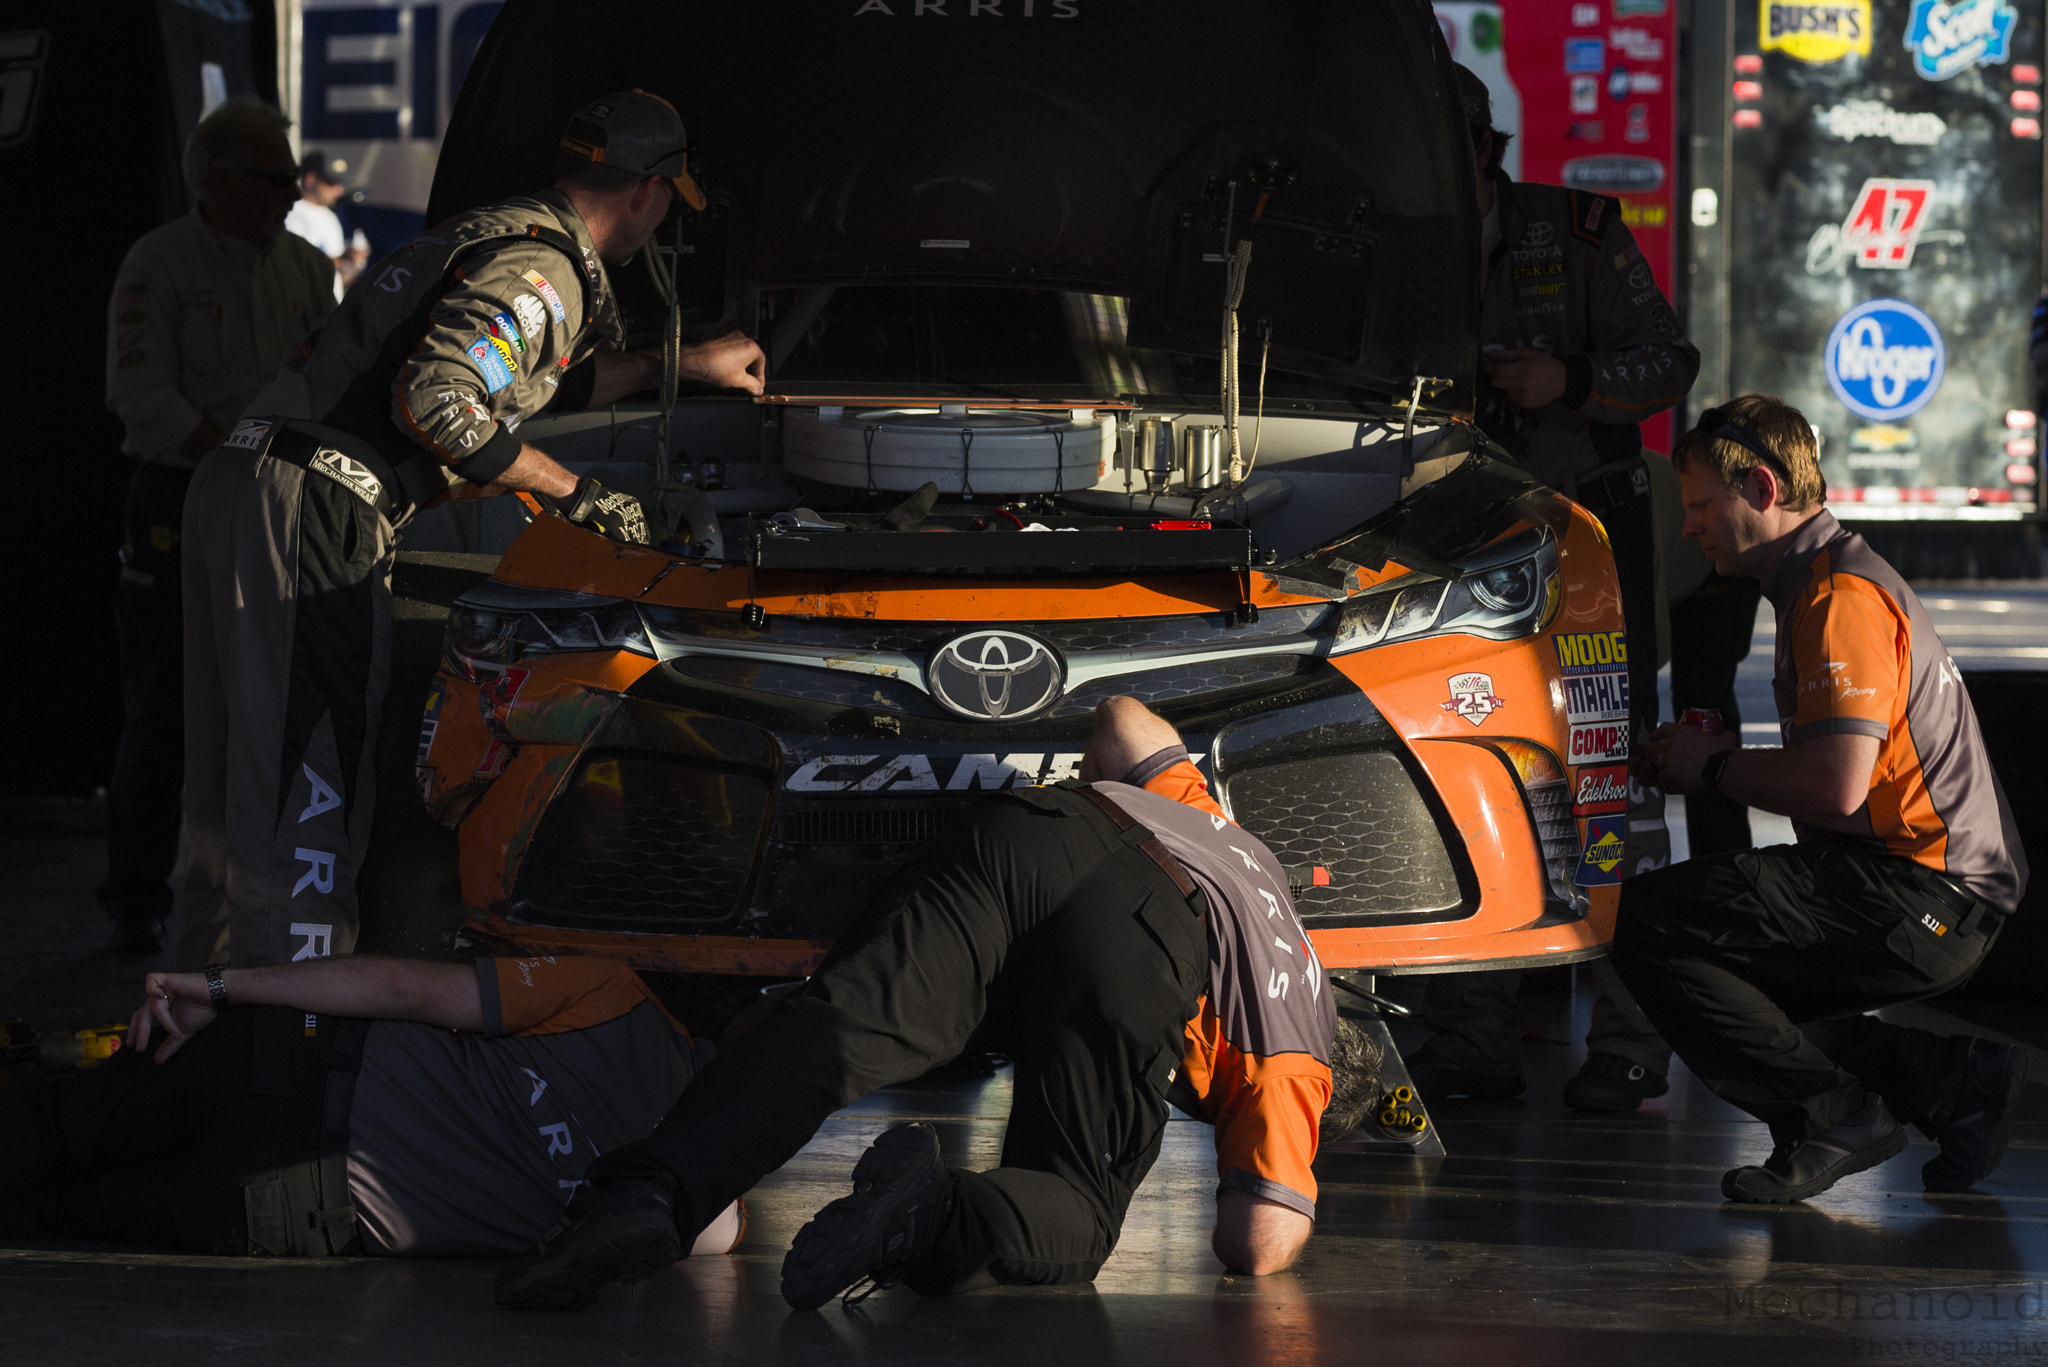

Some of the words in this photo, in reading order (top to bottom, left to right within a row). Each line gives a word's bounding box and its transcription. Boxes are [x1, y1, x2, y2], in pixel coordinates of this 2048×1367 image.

[853, 0, 1080, 18] ARRIS
[1770, 3, 1861, 39] BUSH'S
[1512, 246, 1562, 263] TOYOTA
[1511, 263, 1565, 279] STANLEY
[1516, 281, 1566, 298] SUBWAY
[540, 281, 565, 324] NASCAR
[1838, 316, 1935, 407] Kroger
[224, 433, 264, 449] ARRI
[311, 459, 353, 489] MECHANIX
[351, 484, 377, 506] WEAR
[1556, 631, 1628, 667] MOOG
[1563, 675, 1629, 714] MAHLE
[1799, 677, 1853, 695] ARRIS
[1839, 686, 1877, 702] Racing
[1456, 690, 1494, 717] 25
[1572, 727, 1618, 756] COMP
[1605, 747, 1627, 758] CAMS
[1921, 912, 1940, 932] 5.11
